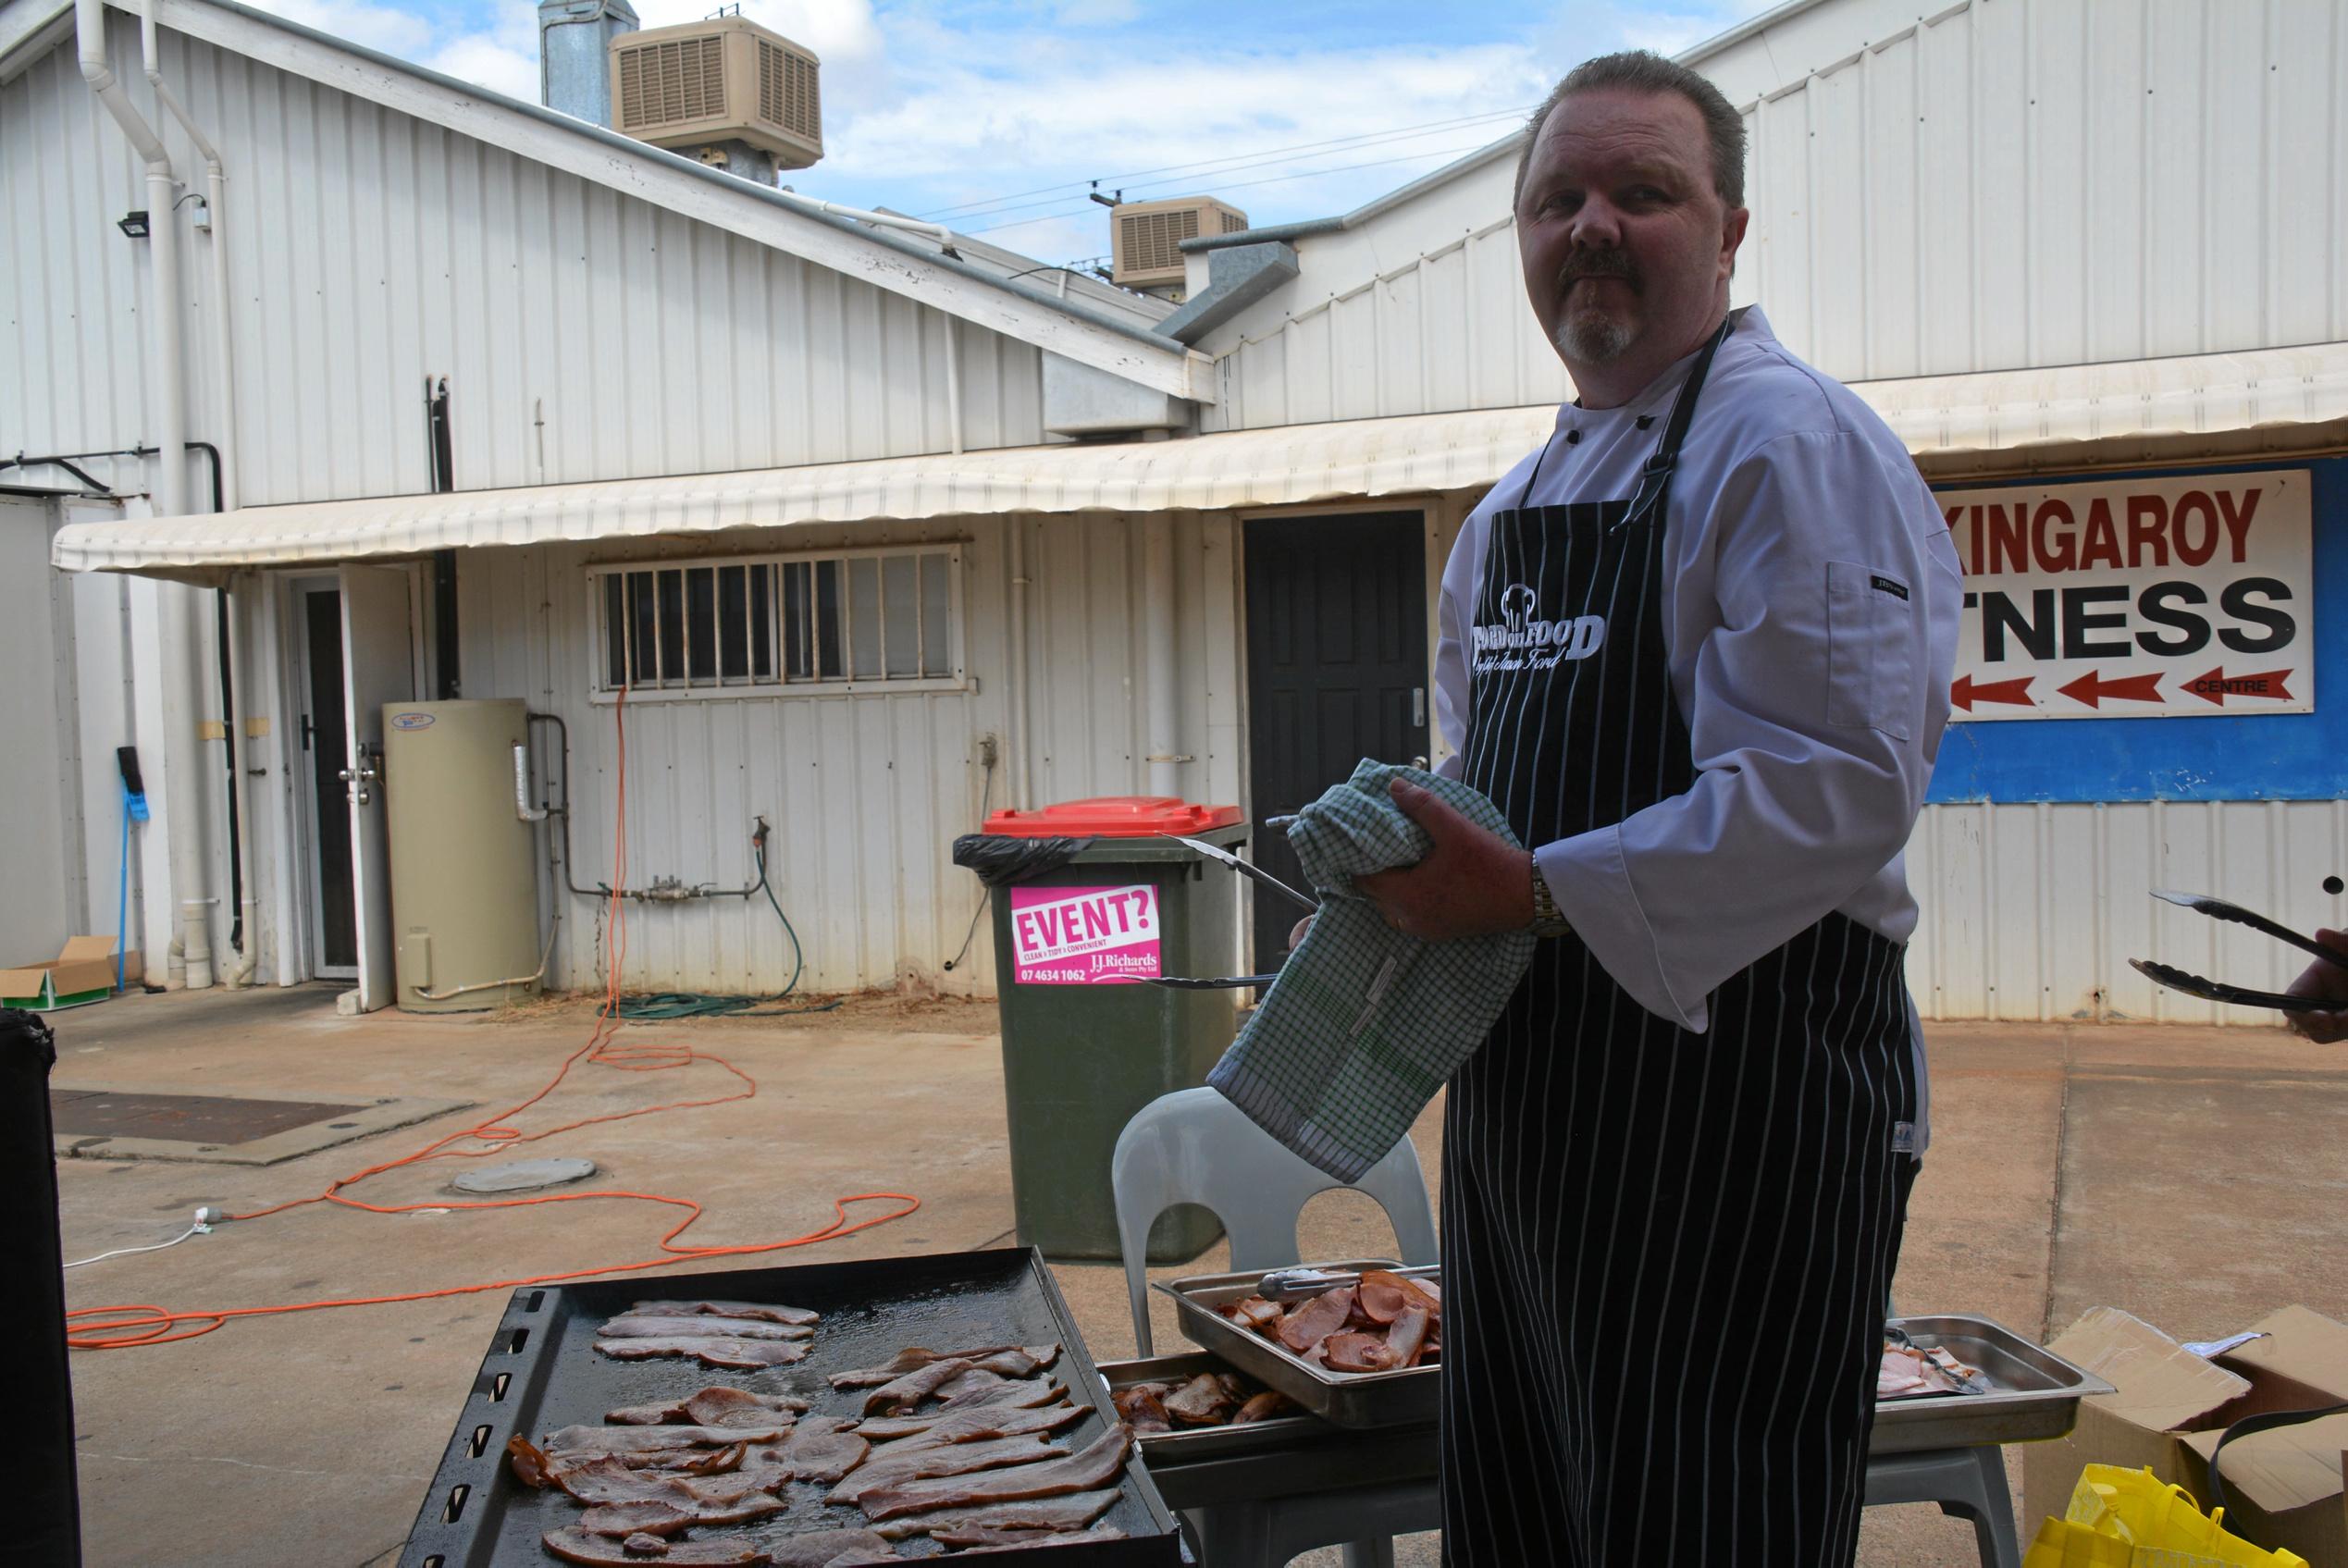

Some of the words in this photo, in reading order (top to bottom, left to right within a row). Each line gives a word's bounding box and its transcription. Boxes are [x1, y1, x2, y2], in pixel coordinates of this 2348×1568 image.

[1962, 577, 2296, 662] NESS
[2194, 679, 2268, 693] CENTRE
[1016, 889, 1149, 953] EVENT?
[1024, 952, 1043, 962] CLEAN
[1047, 947, 1062, 957] TIDY
[1067, 939, 1106, 954] CONVENIENT
[1021, 969, 1033, 981] 07
[1034, 969, 1059, 981] 4634
[1061, 969, 1086, 982] 1062
